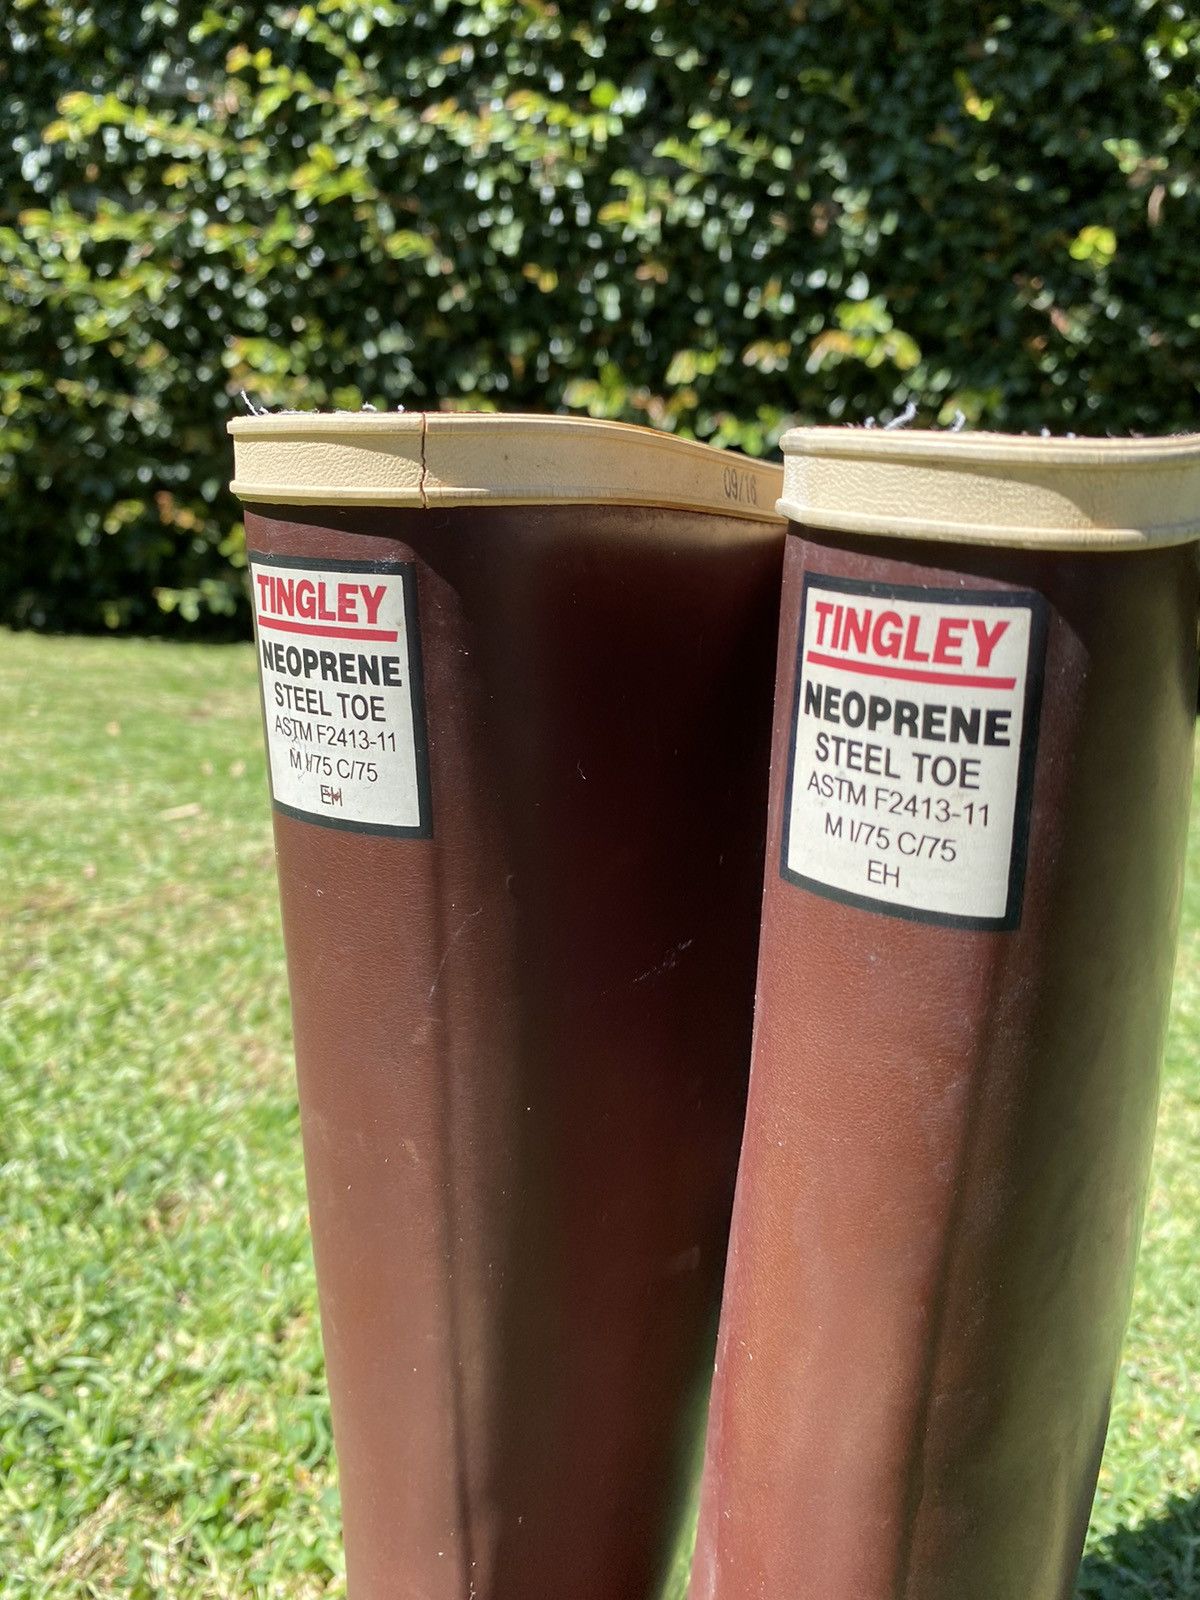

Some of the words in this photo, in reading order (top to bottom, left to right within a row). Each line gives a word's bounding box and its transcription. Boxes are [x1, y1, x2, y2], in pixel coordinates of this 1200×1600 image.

[257, 574, 387, 624] TINGLEY
[815, 602, 1010, 667] TINGLEY
[262, 640, 402, 686] NEOPRENE
[274, 682, 332, 716] STEEL
[337, 692, 386, 722] TOE
[804, 680, 1012, 746] NEOPRENE
[275, 715, 312, 742] ASTM
[317, 724, 396, 752] F2413-11
[290, 749, 302, 771] M
[337, 759, 378, 782] C/75
[815, 732, 900, 779] STEEL
[912, 752, 981, 789] TOE
[807, 771, 866, 806] ASTM
[874, 788, 988, 826] F2413-11
[825, 813, 842, 838] M
[898, 832, 957, 862] C/75
[867, 859, 899, 887] EH
